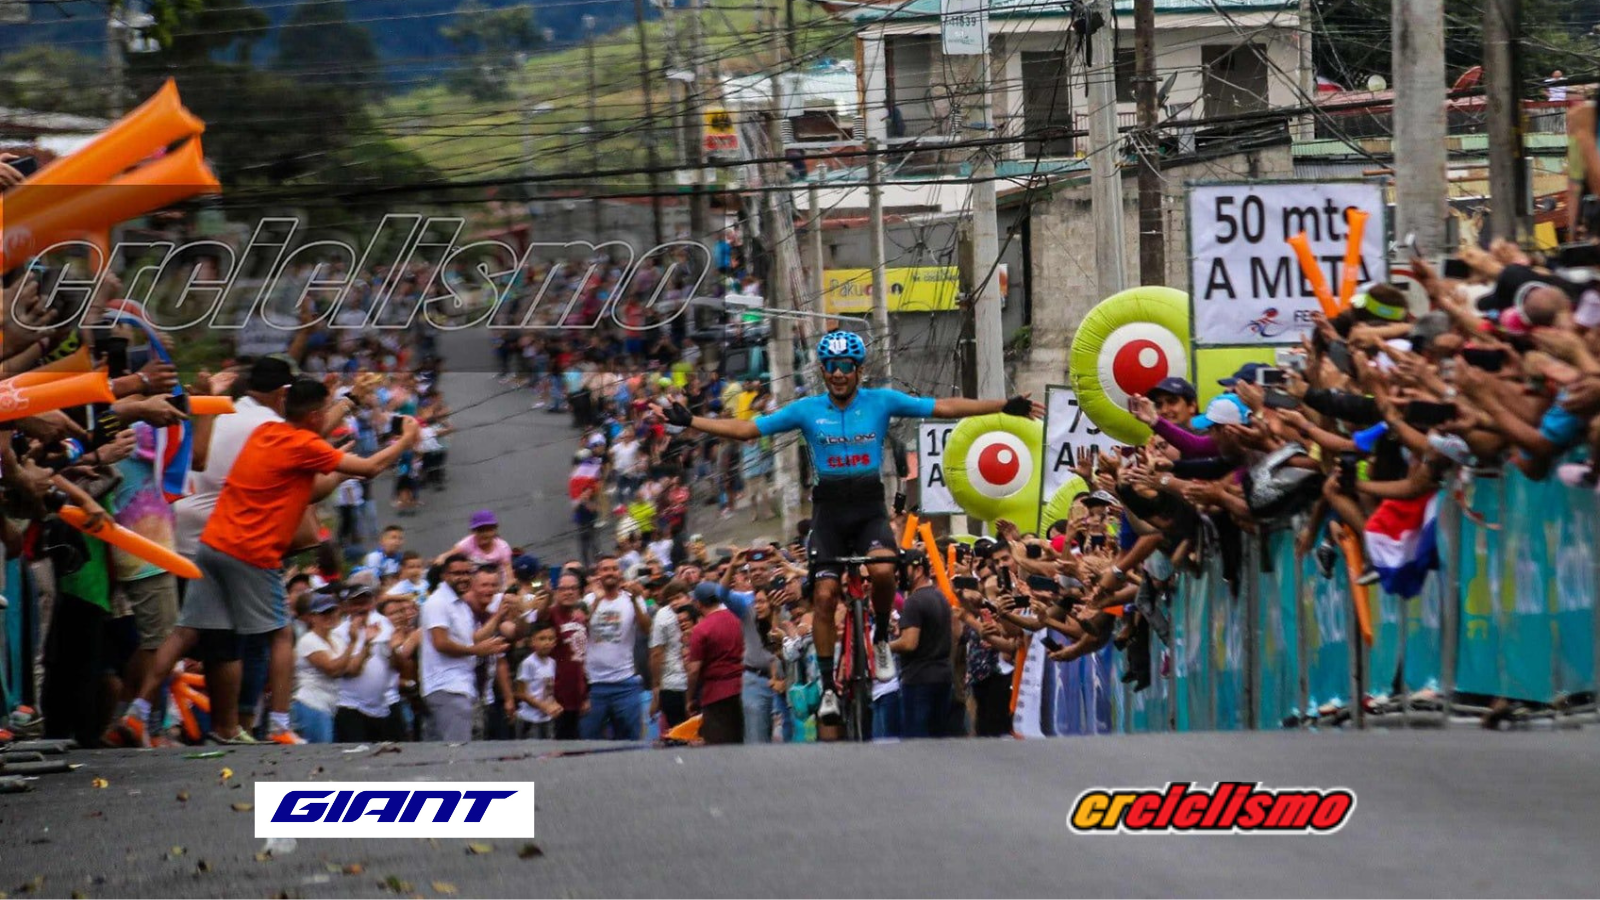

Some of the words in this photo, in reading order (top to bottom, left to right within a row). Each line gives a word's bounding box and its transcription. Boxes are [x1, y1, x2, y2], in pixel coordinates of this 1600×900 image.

[1215, 195, 1265, 244] 50
[1204, 257, 1237, 299] A
[1068, 399, 1101, 435] 7
[827, 454, 870, 469] CLIPS
[1053, 442, 1076, 472] A
[927, 463, 946, 488] A
